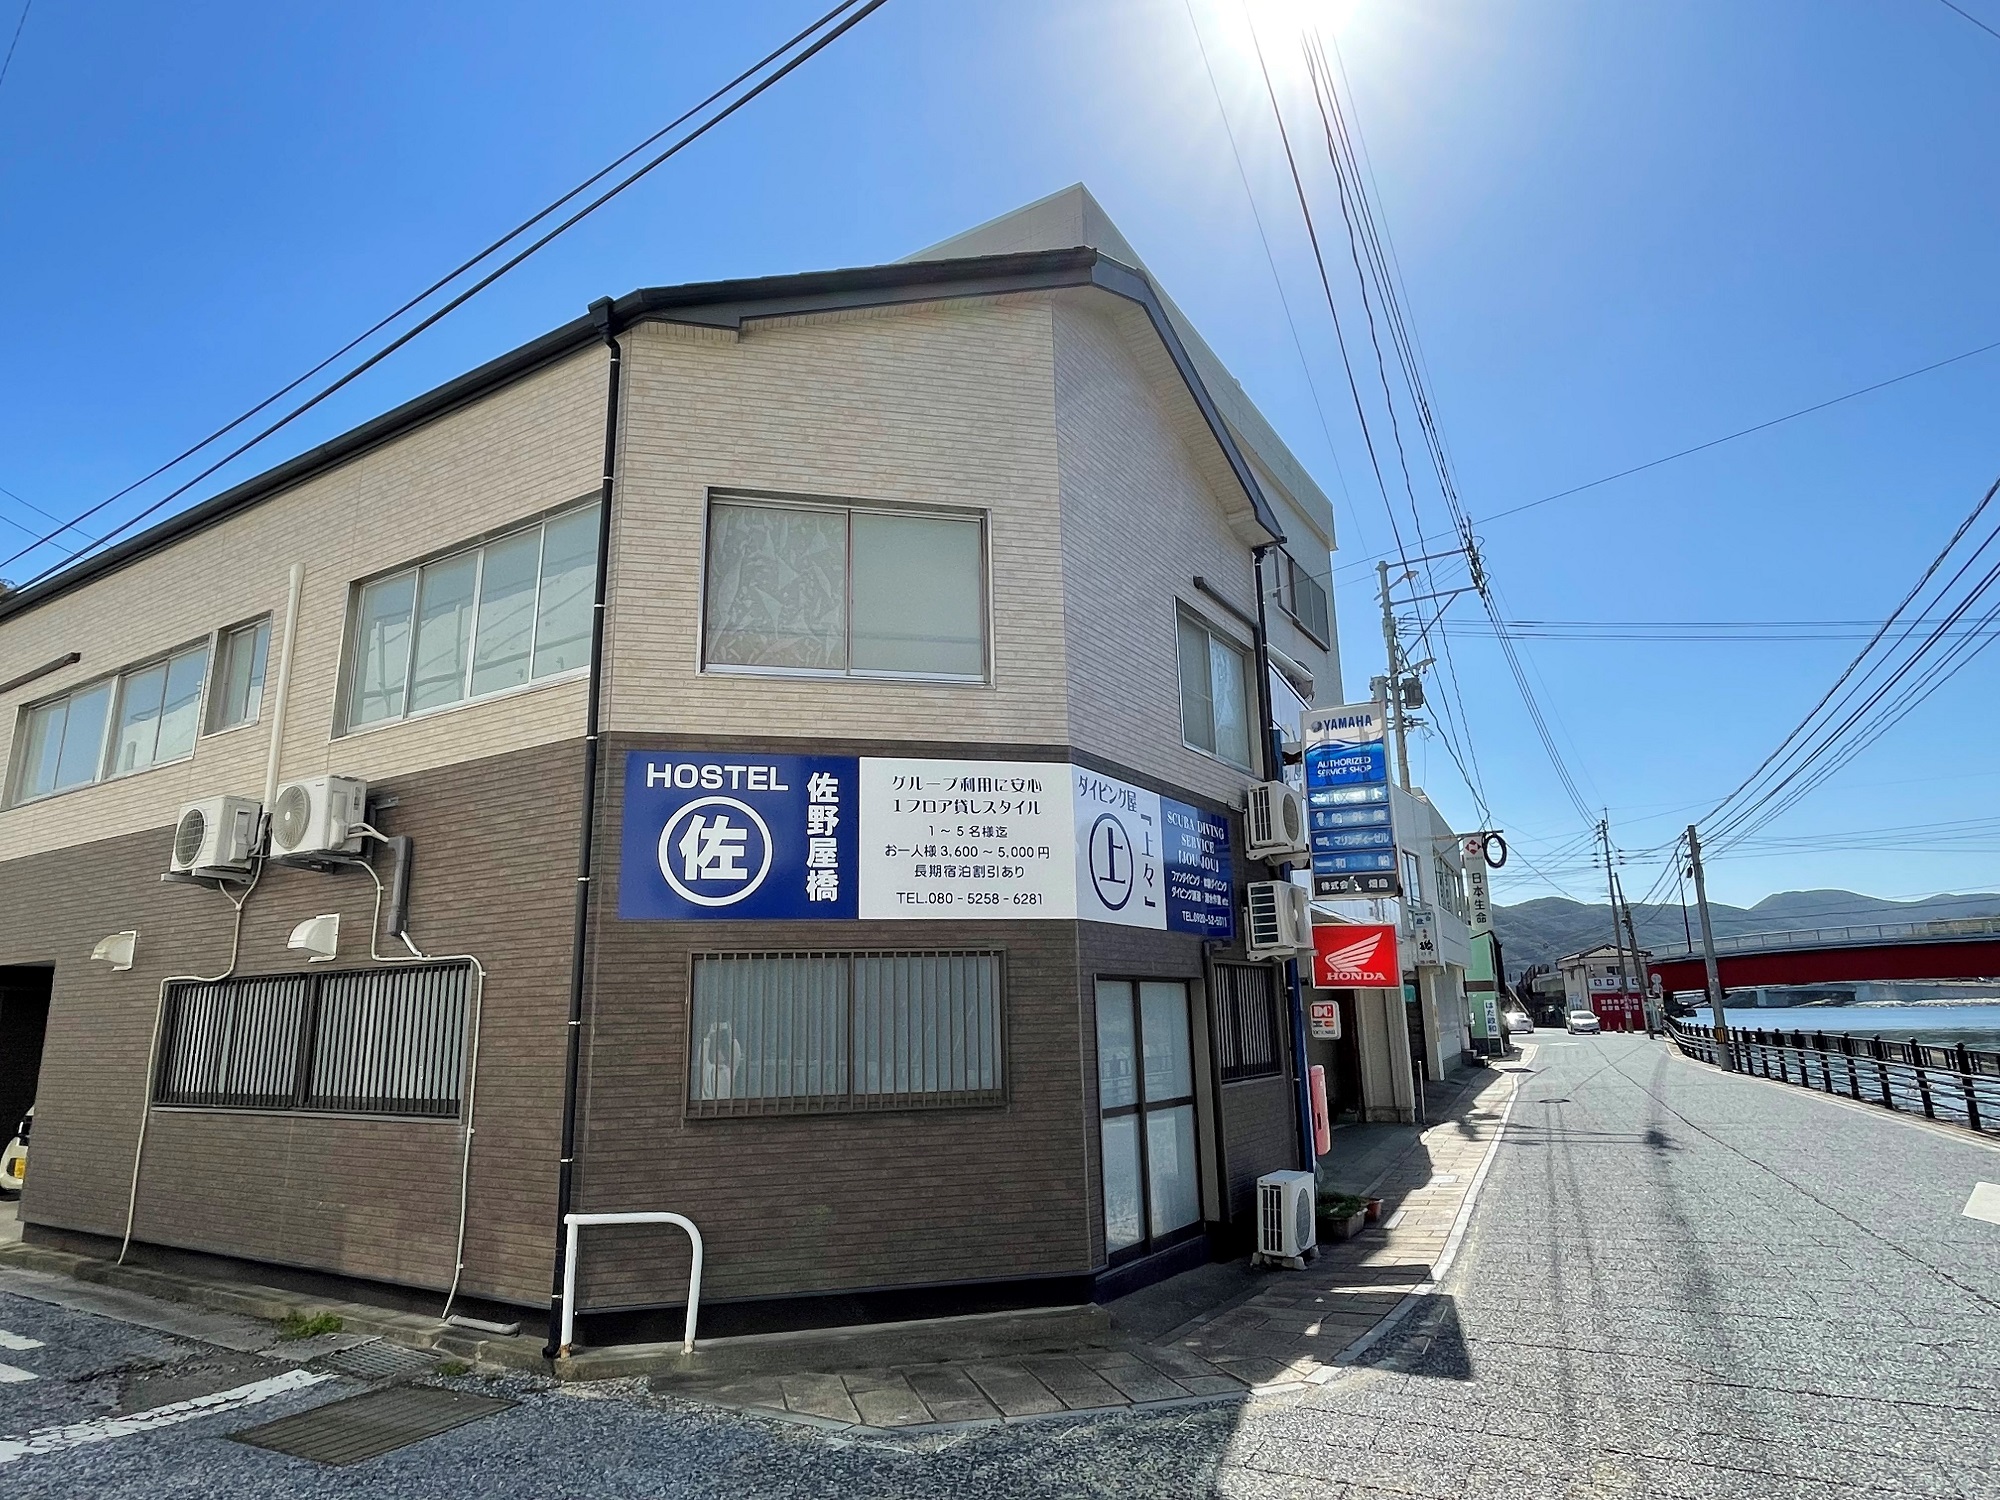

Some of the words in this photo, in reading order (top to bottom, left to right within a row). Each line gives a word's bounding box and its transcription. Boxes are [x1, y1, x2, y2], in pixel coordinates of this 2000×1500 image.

[1324, 714, 1373, 731] YAMAHA
[1317, 756, 1371, 769] AUTHORIZED
[646, 763, 789, 791] HOSTEL
[1317, 766, 1347, 778] SERVICE
[1349, 765, 1372, 773] SHOP
[892, 776, 1043, 793] グループ利用に安心
[1078, 775, 1138, 813] ダイビング屋
[1167, 810, 1195, 831] SCUBA
[1197, 820, 1224, 840] DIVING
[806, 772, 840, 902] 佐野屋橋
[1181, 833, 1215, 855] SERVICE
[1334, 832, 1389, 846] マリンディーゼル
[914, 865, 1025, 879] 長期宿泊割引あり
[1471, 872, 1487, 924] 日本生命
[1326, 972, 1386, 980] HONDA
